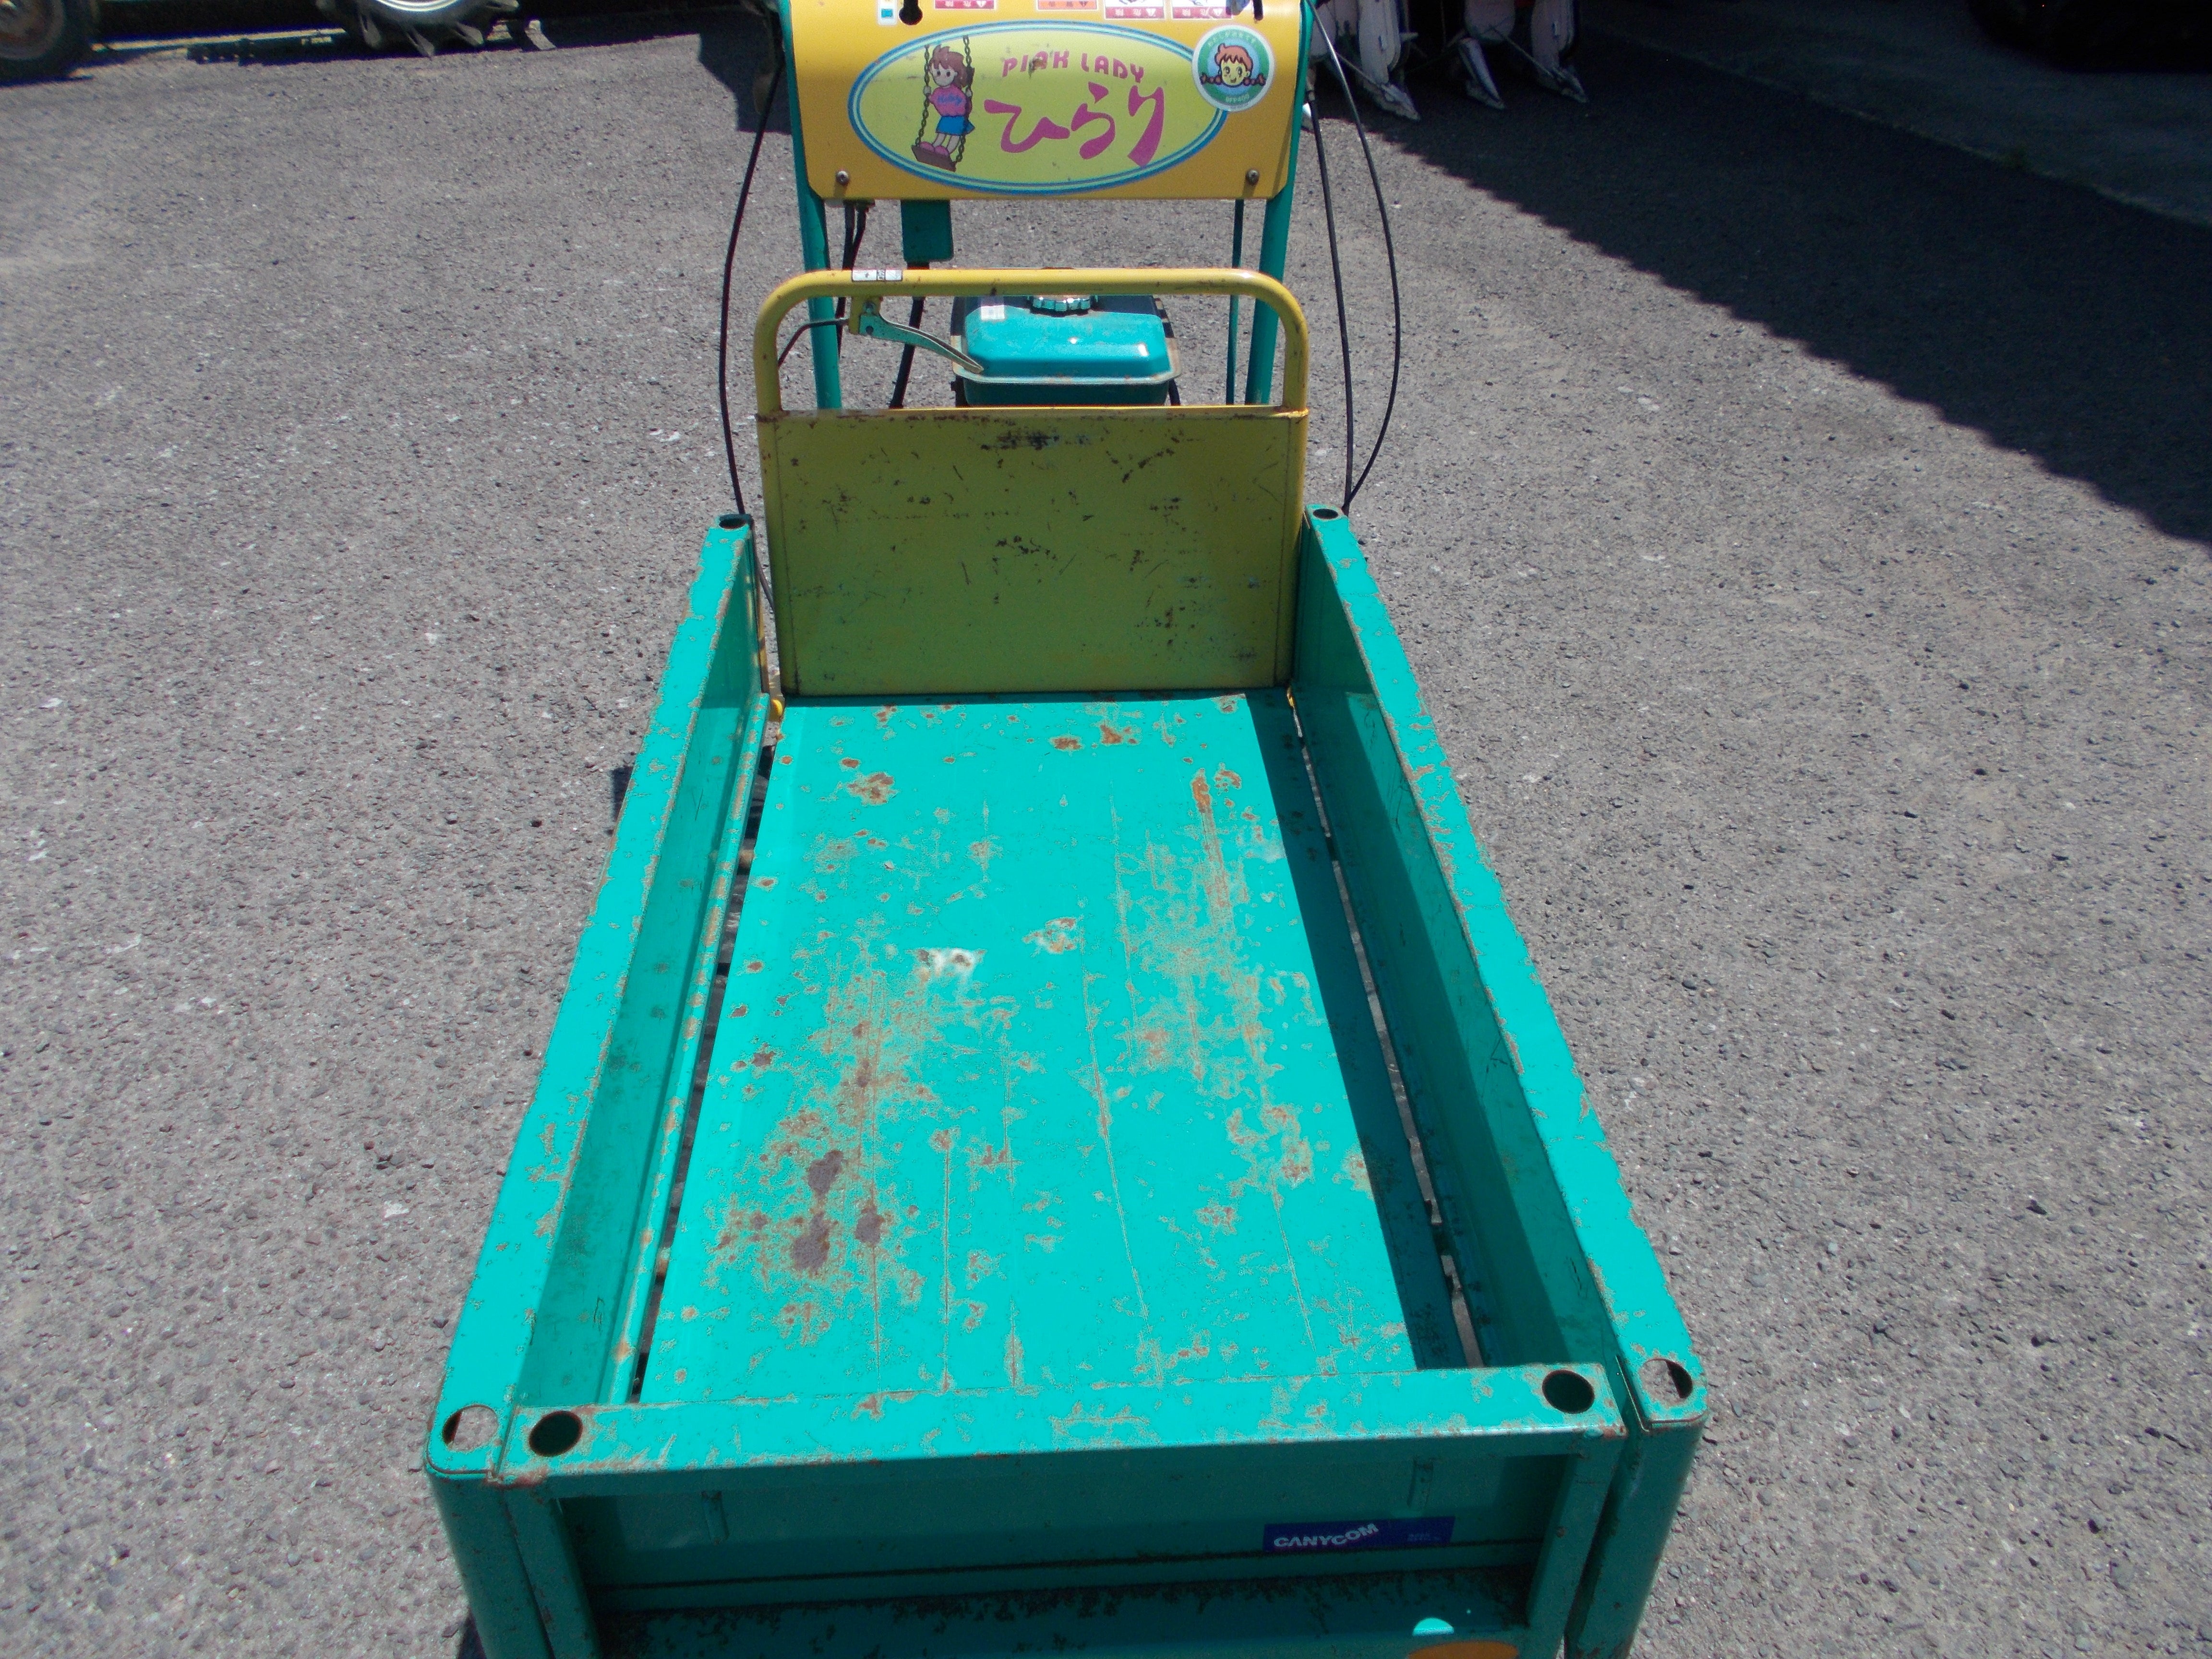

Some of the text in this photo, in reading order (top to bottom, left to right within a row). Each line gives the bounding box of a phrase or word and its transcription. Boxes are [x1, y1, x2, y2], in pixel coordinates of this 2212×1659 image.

[1081, 53, 1144, 84] LADY
[984, 81, 1165, 167] ひらり
[1274, 1523, 1379, 1547] CANYCOM
